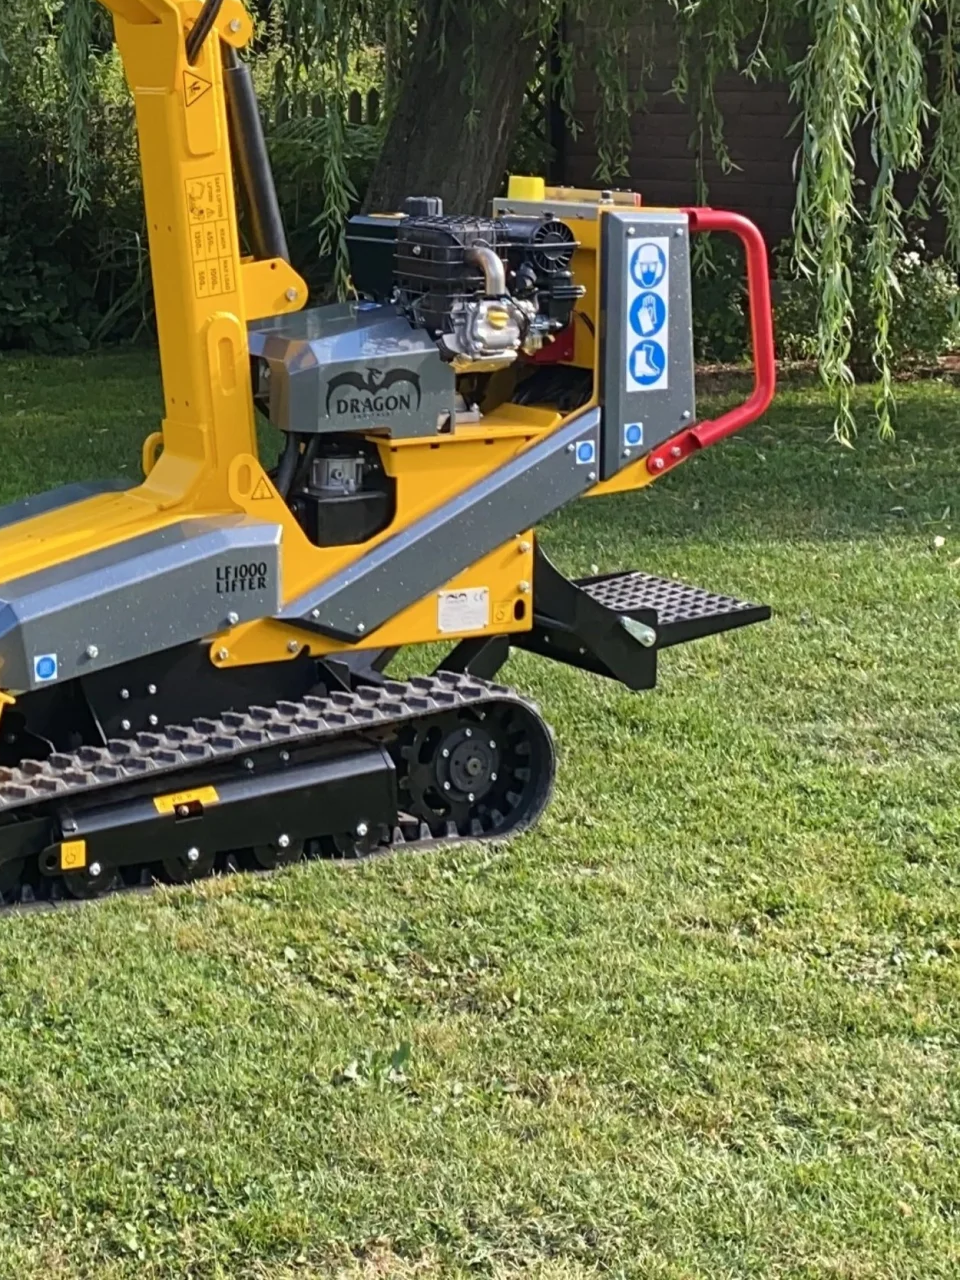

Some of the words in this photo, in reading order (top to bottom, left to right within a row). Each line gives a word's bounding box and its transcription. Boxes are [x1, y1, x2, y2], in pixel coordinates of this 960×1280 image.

[337, 394, 411, 414] DRAGON
[216, 561, 267, 580] LF1000
[216, 576, 267, 593] LIFTER
